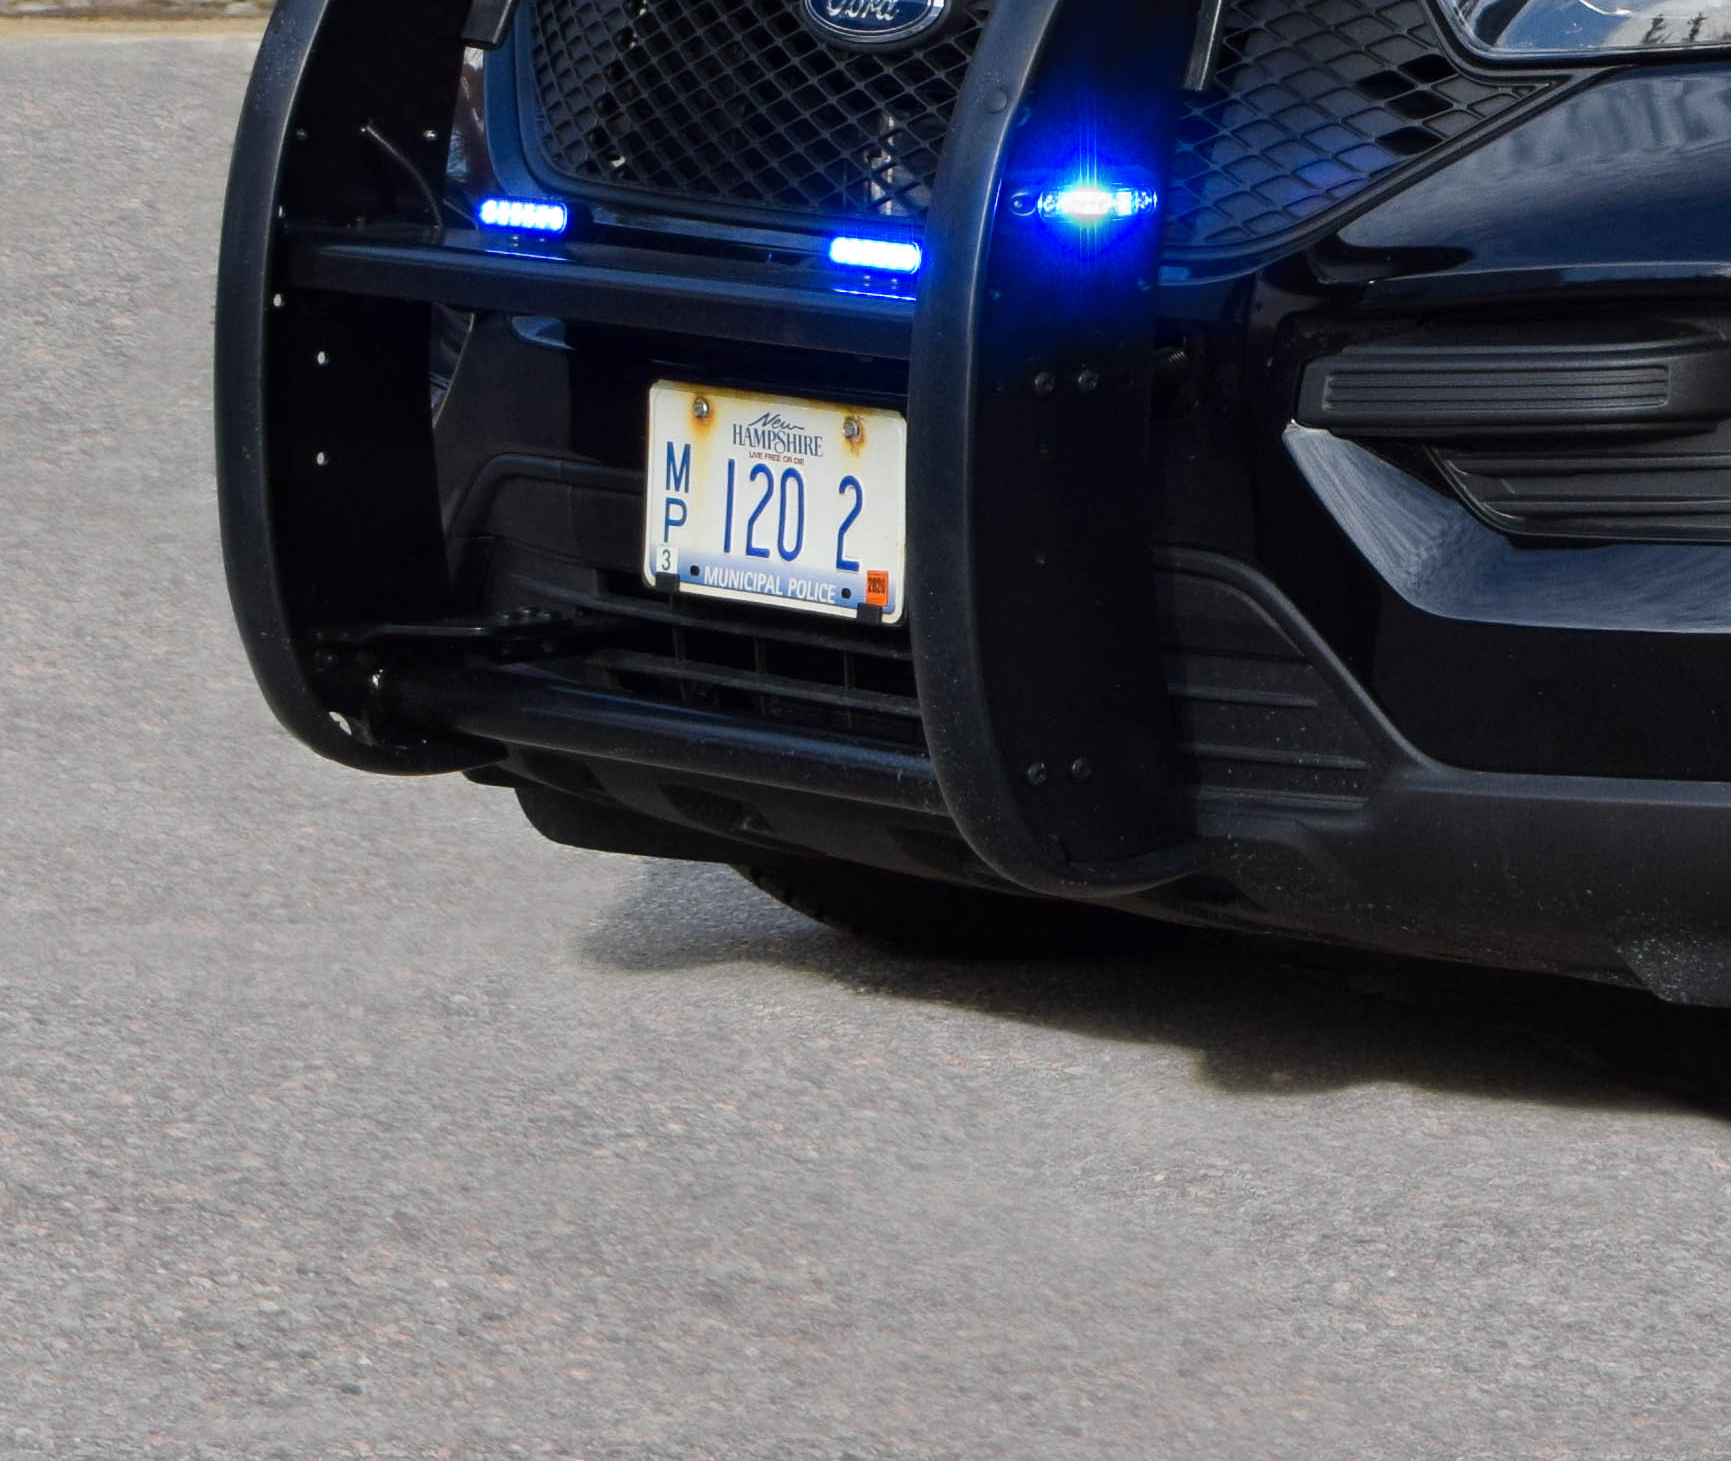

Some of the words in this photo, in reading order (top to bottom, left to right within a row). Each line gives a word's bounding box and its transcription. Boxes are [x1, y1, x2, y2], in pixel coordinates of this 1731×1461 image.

[747, 412, 805, 431] New
[732, 423, 823, 458] HAMPSHIRE
[749, 450, 763, 460] LIVE
[764, 453, 781, 462] FREE
[782, 455, 793, 464] OR
[723, 458, 805, 562] 120
[835, 475, 863, 572] 2
[661, 549, 671, 571] 3
[703, 565, 783, 595] MUNICIPAL
[787, 577, 837, 604] POLICE
